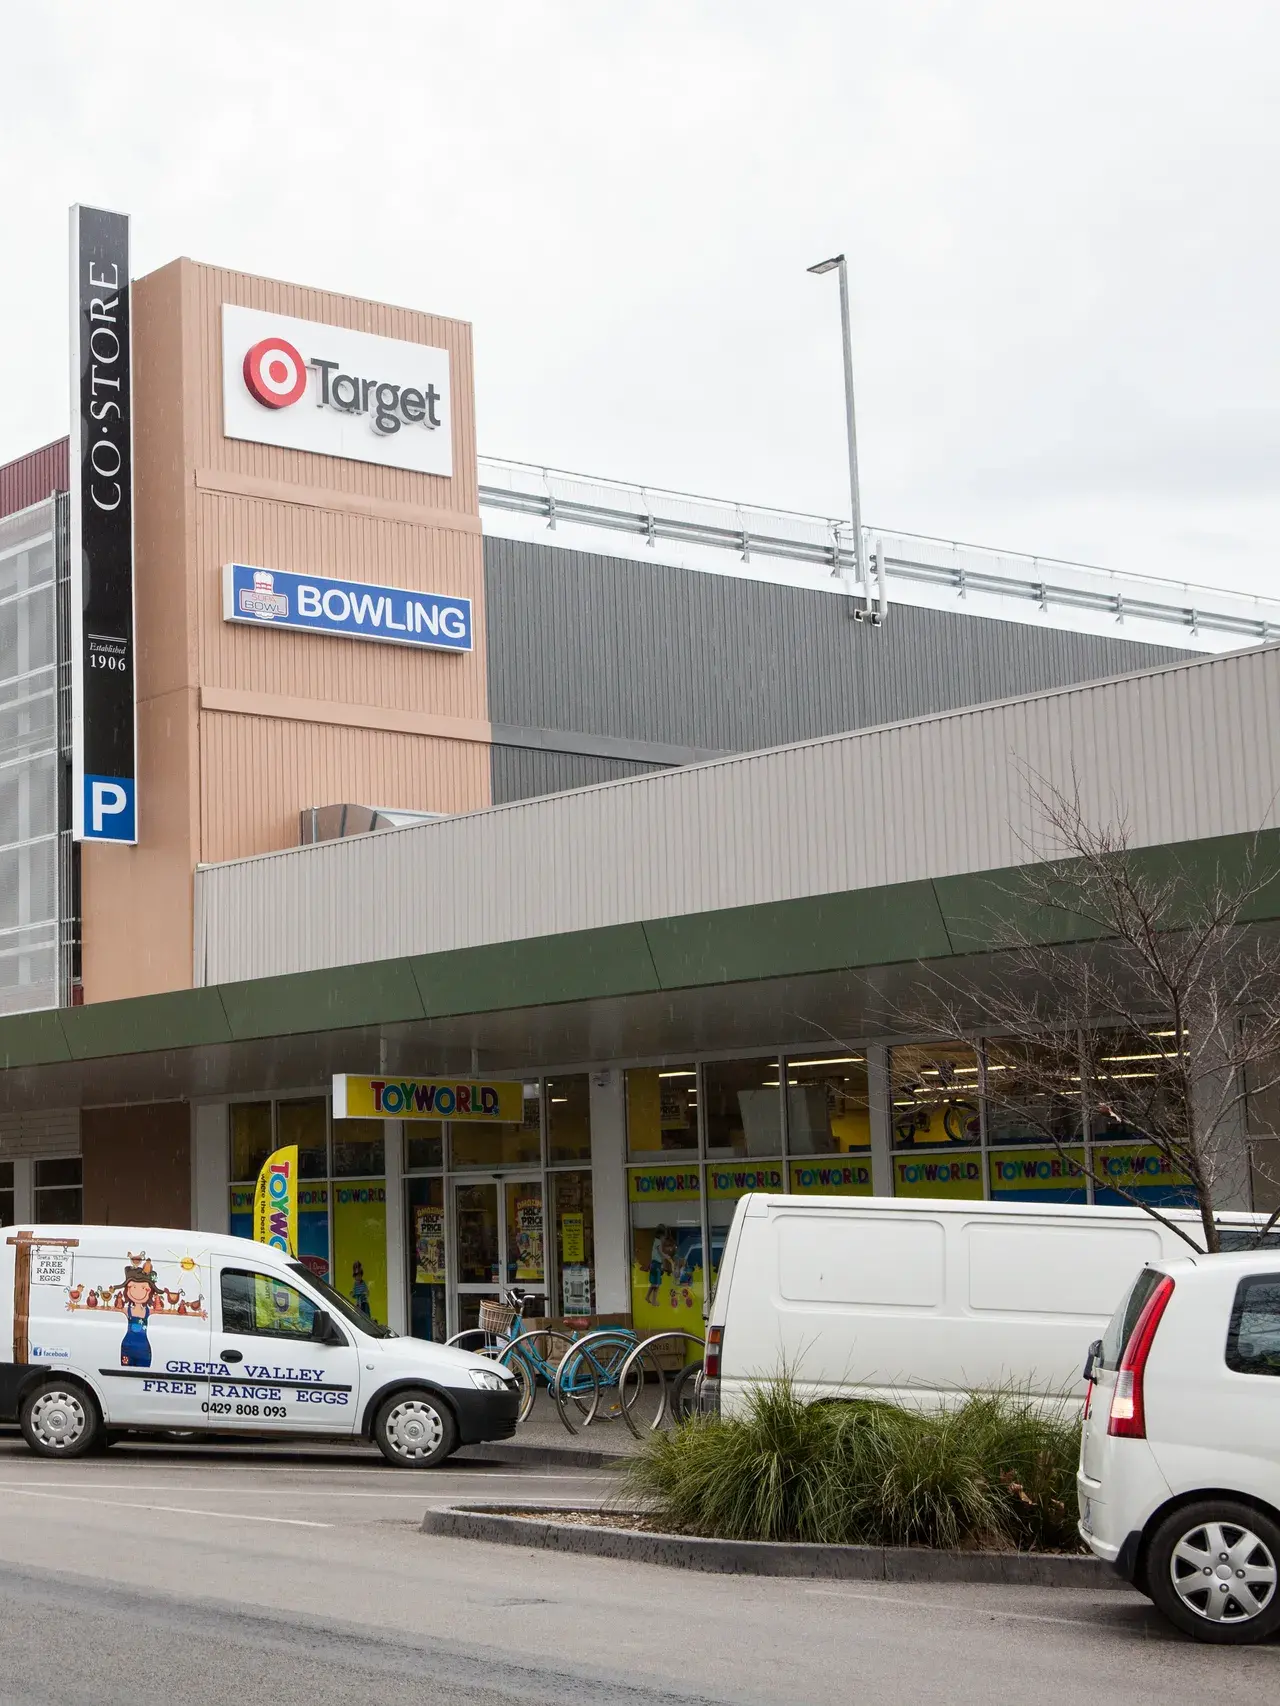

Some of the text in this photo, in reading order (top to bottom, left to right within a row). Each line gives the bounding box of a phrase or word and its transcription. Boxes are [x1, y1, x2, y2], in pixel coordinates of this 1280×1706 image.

[308, 357, 441, 435] Target
[244, 600, 284, 613] BOWL
[251, 593, 277, 603] SUPA
[297, 584, 466, 639] BOWLING
[89, 642, 126, 654] Established
[90, 654, 126, 671] 1906
[92, 781, 127, 831] P
[370, 1081, 498, 1114] TOYWORLD
[711, 1169, 782, 1190] TOYWORLD
[795, 1168, 869, 1187] TOYWORLD
[898, 1161, 980, 1183] TOYWORLD
[634, 1175, 699, 1193] TOYWORLD
[335, 1187, 385, 1204] TOYWORLD
[421, 1223, 441, 1231] PRICE
[36, 1267, 66, 1275] RANGE
[43, 1350, 68, 1358] facebook
[166, 1360, 325, 1381] GRETA VALLEY
[143, 1380, 349, 1405] FREE RANGE EGGS
[201, 1402, 287, 1418] 0429 808 093
